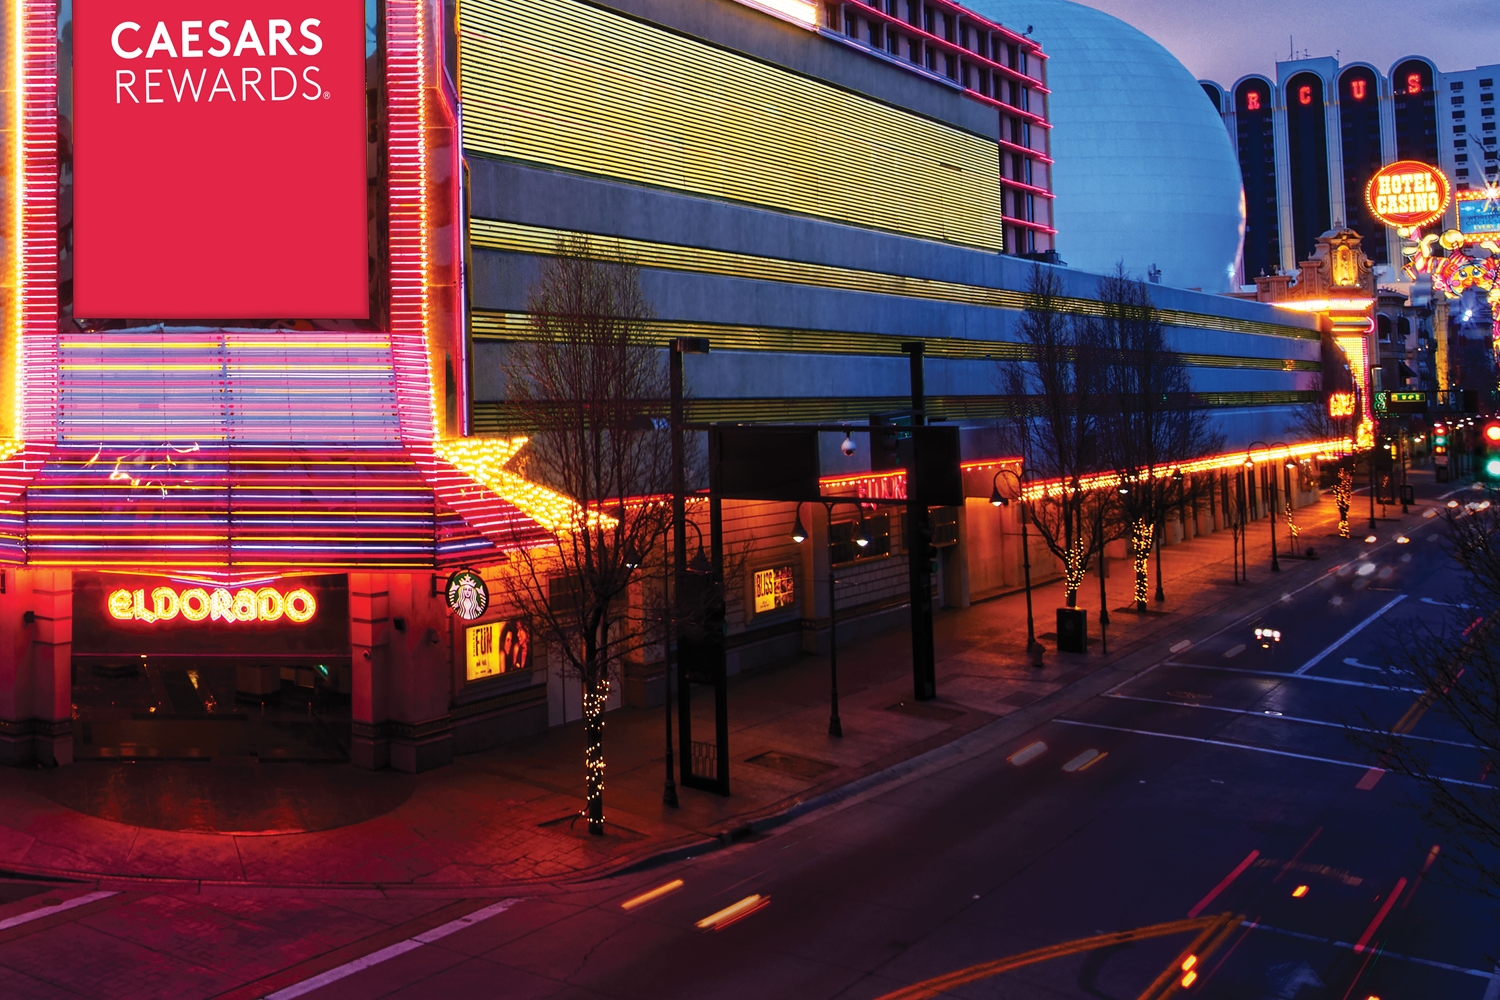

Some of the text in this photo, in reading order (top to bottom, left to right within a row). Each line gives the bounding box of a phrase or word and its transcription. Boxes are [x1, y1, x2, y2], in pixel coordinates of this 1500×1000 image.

[111, 18, 323, 59] CAESARS
[1378, 173, 1437, 195] HOTEL
[1376, 192, 1439, 215] CASINO
[757, 572, 773, 598] BLISS
[108, 587, 317, 624] ELDORADO
[476, 626, 492, 657] FUN
